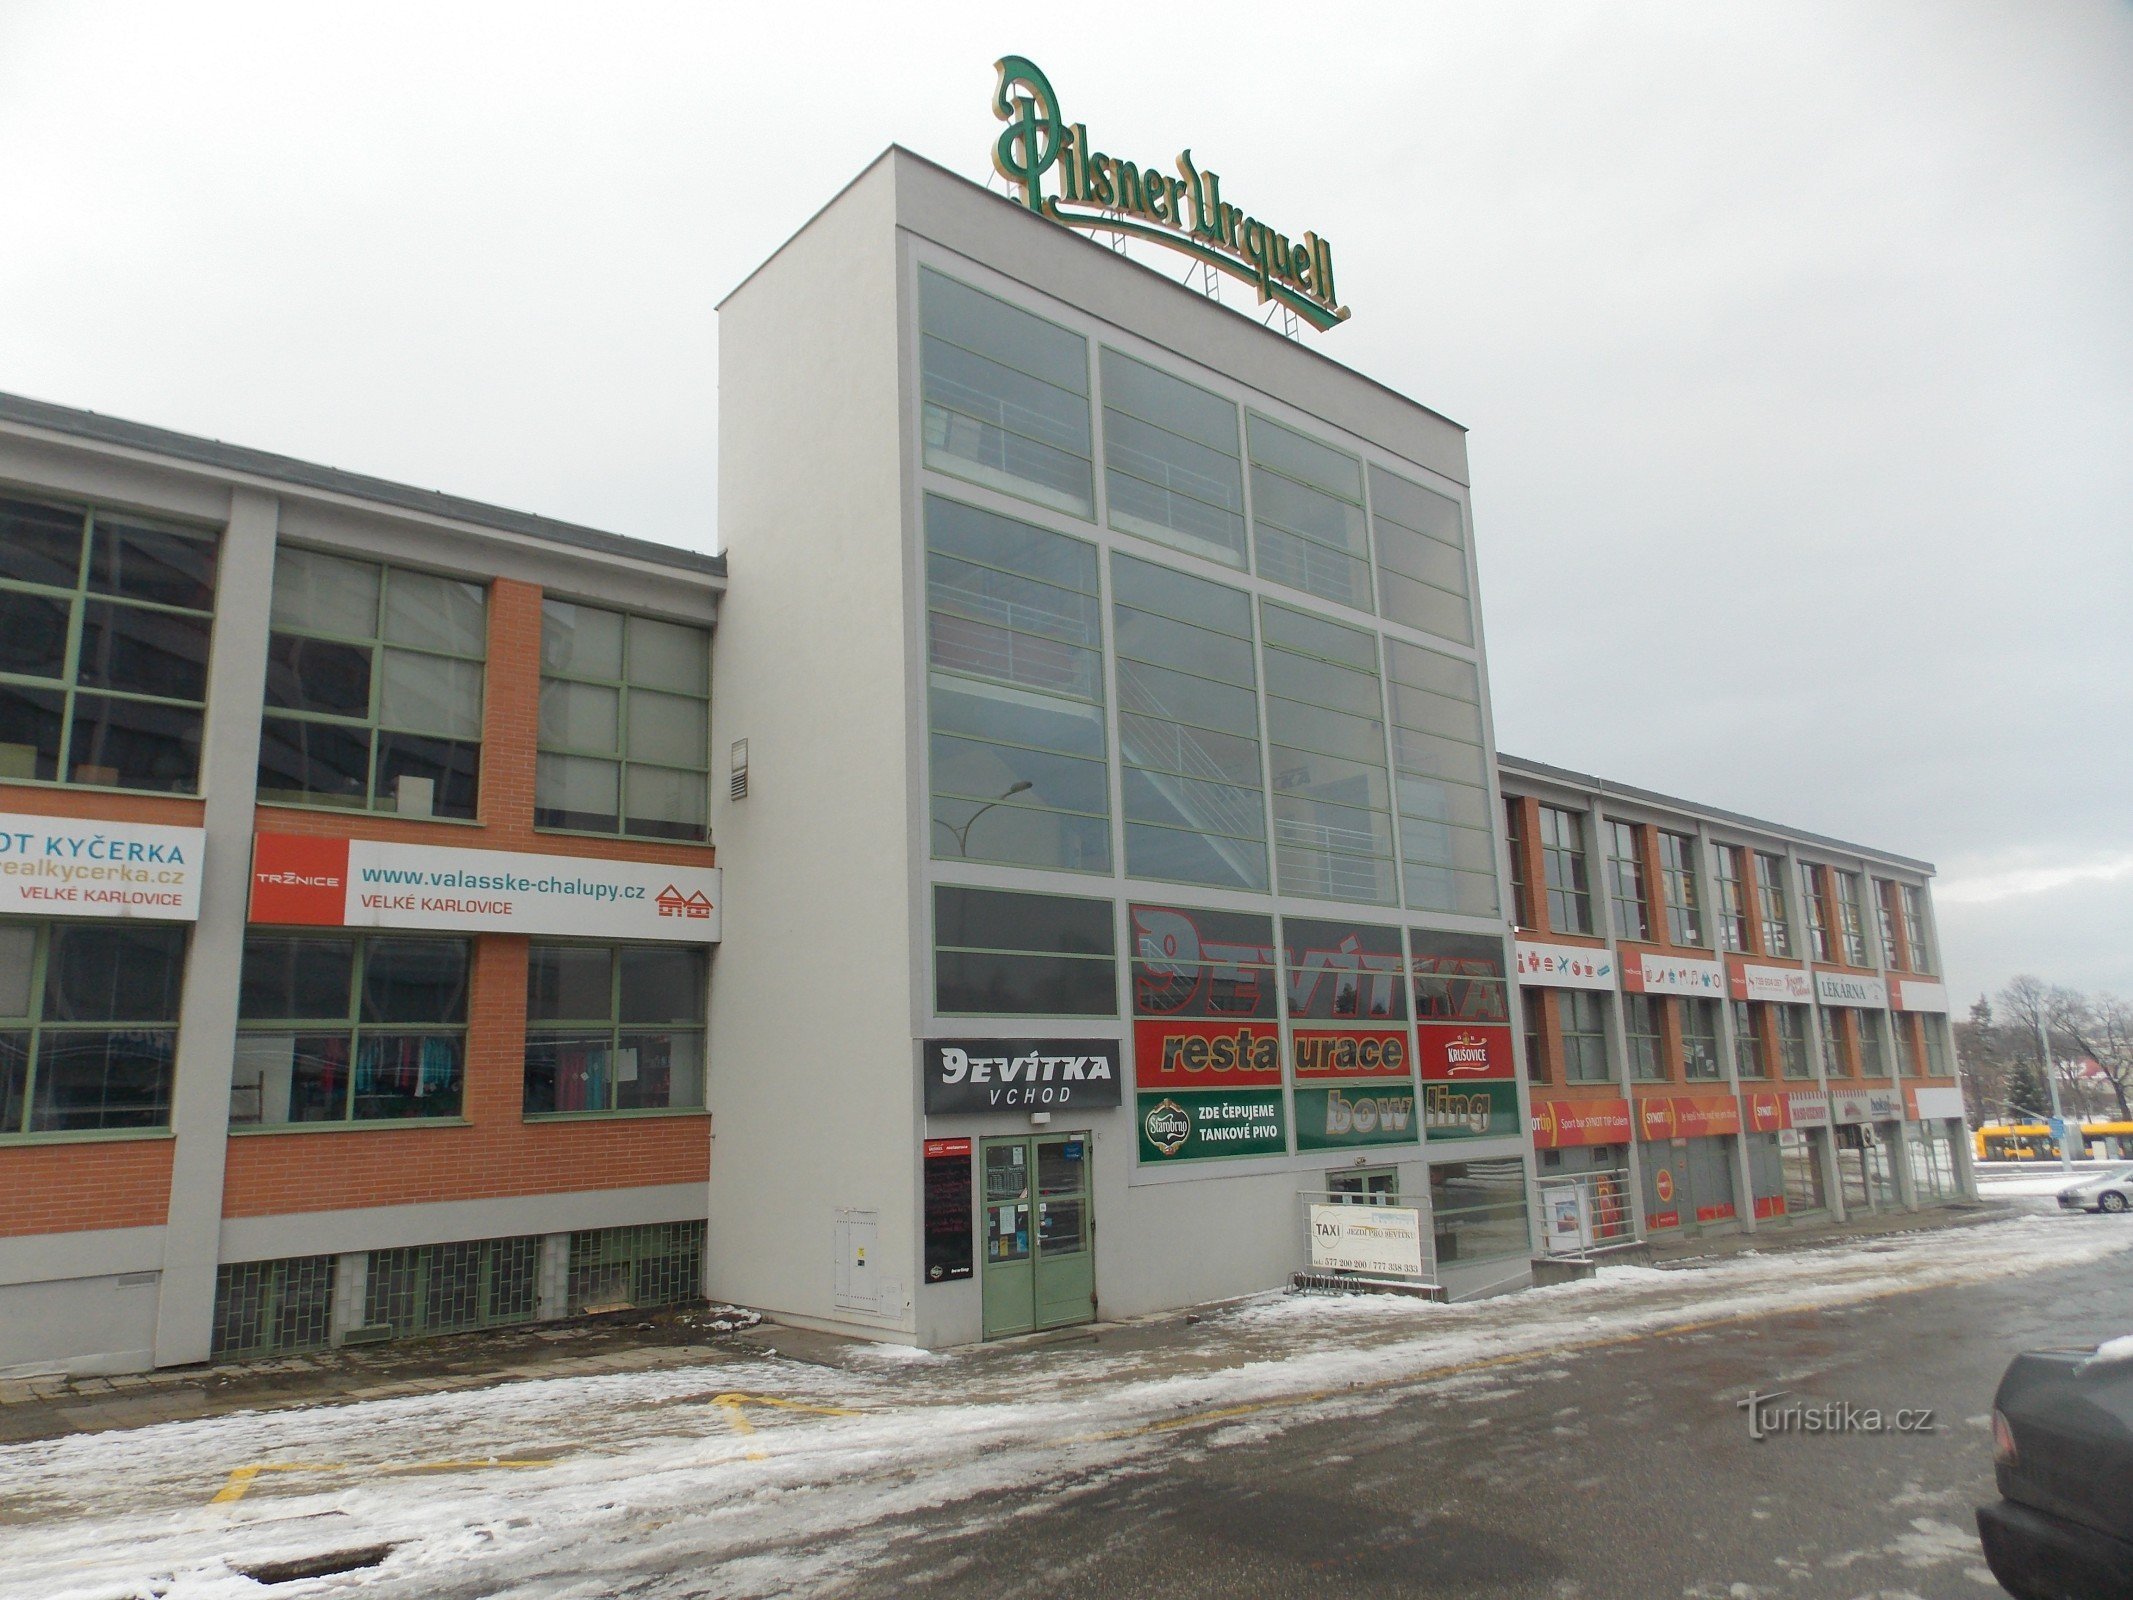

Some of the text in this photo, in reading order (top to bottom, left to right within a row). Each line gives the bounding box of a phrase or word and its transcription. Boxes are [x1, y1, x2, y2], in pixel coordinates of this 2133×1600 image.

[991, 55, 1338, 309] Pilsner Urquell
[46, 834, 185, 864] KYČERKA
[257, 872, 339, 887] TRŽNICE
[362, 867, 645, 901] www.valasske-chalupy.cz
[19, 885, 182, 906] VELKÉ KARLOVICE
[361, 893, 513, 915] VELKÉ KARLOVICE
[1821, 977, 1866, 1000] LÉKÁRNA
[1447, 1046, 1487, 1063] KRUŠOVICE
[940, 1048, 1112, 1084] 9EVÍTKA
[990, 1086, 1071, 1105] VCHOD
[1198, 1103, 1275, 1121] ZDE ČEPUJEME
[1149, 1114, 1188, 1140] Starobrno
[1200, 1123, 1278, 1141] TANKOVÉ PIVO
[1531, 1113, 1552, 1133] OTtip
[1561, 1115, 1628, 1130] Sport bar SYNOT TIP Golem
[1316, 1223, 1340, 1237] TAXI
[1368, 1230, 1382, 1238] PRO
[1325, 1257, 1338, 1266] 577
[1340, 1258, 1352, 1267] 200
[1353, 1259, 1367, 1269] 200
[1373, 1261, 1386, 1271] 777
[1403, 1263, 1419, 1274] 333
